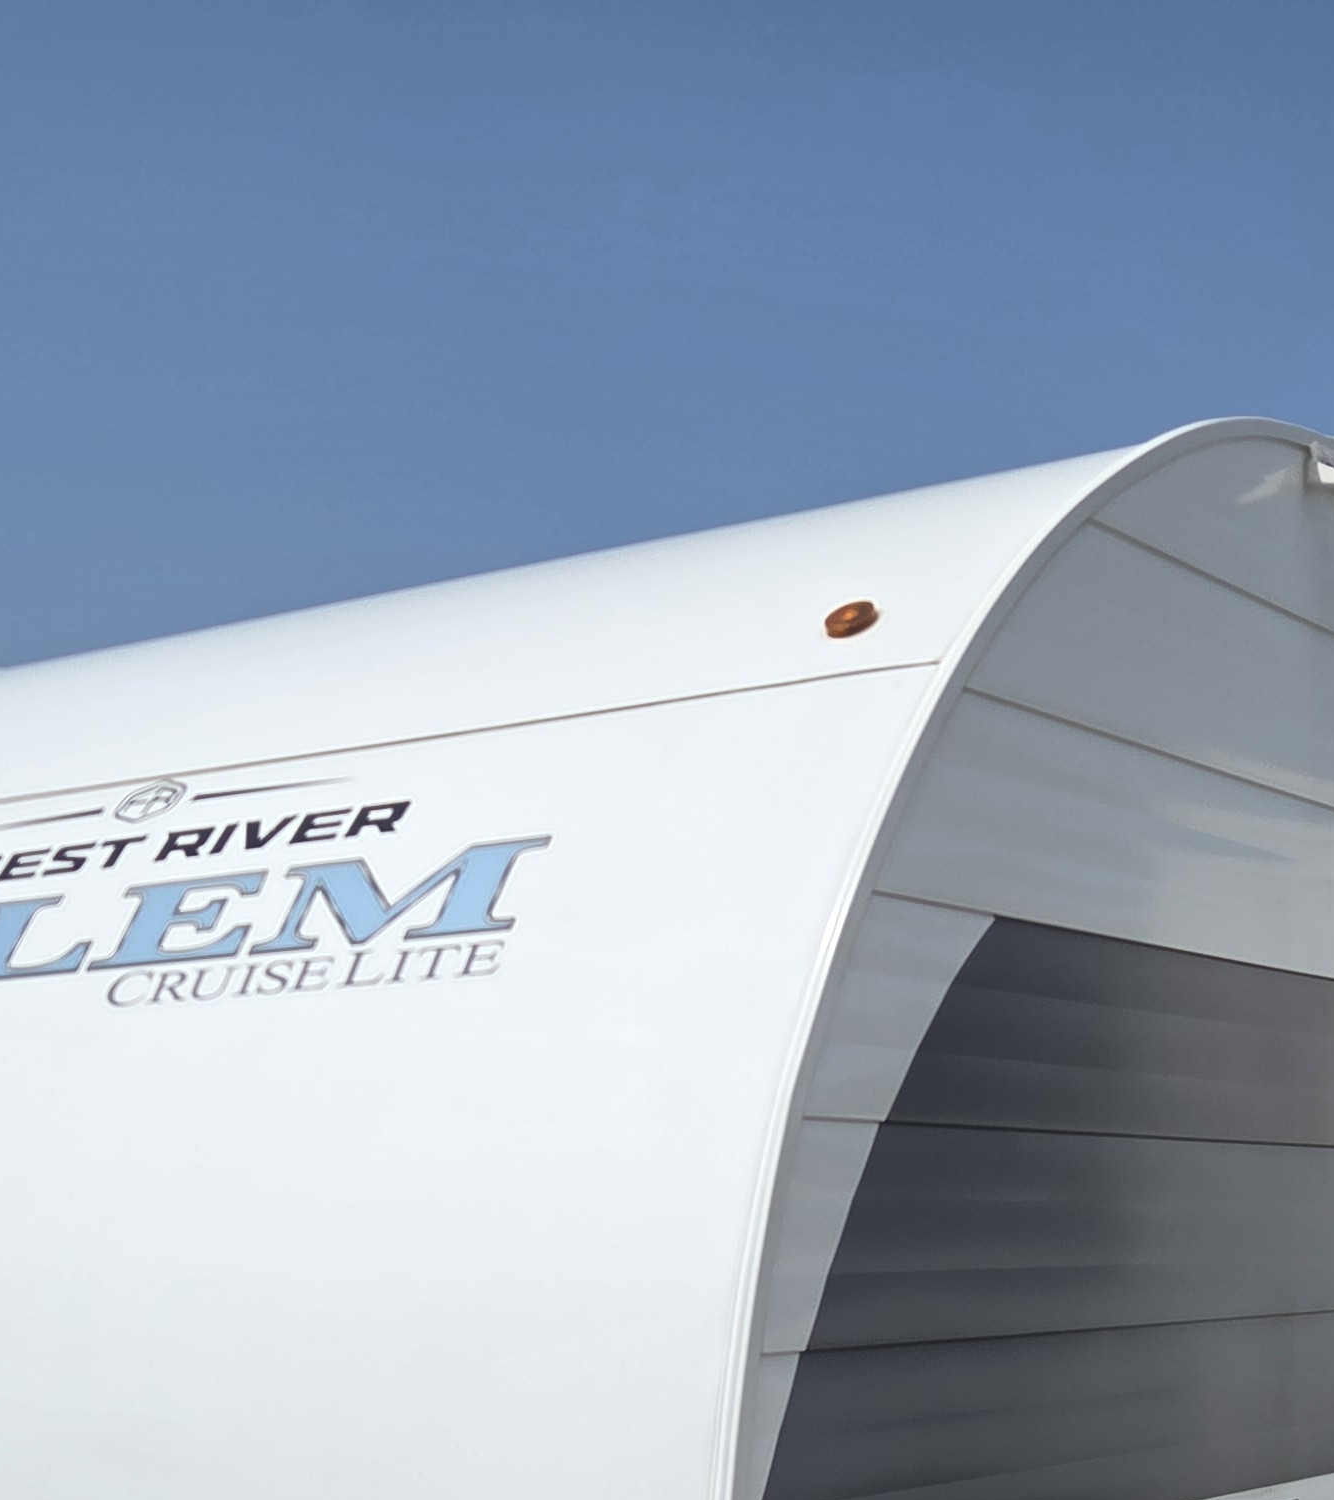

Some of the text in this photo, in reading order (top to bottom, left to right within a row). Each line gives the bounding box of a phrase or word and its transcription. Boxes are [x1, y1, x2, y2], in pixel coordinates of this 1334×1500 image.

[154, 801, 411, 862] RIVER
[107, 940, 505, 1007] CRUISE LITE
